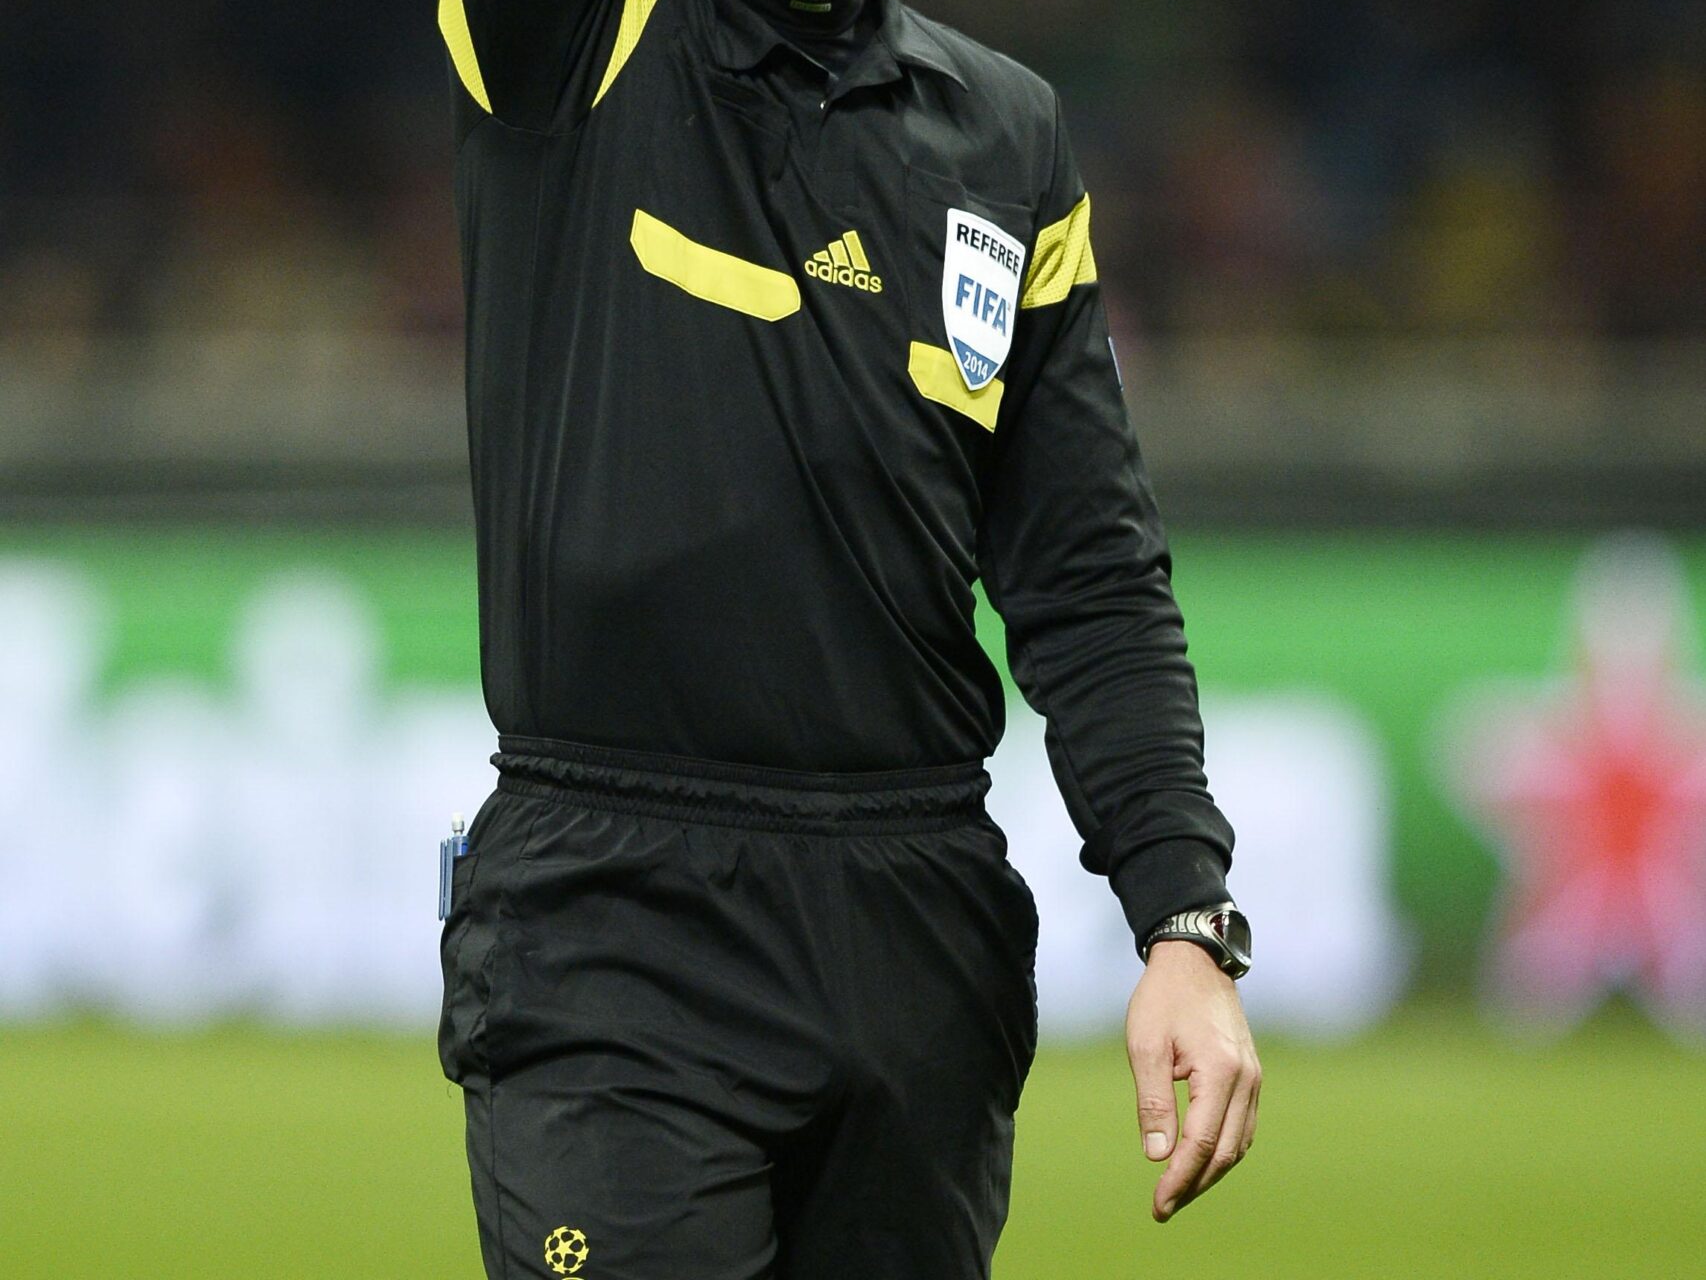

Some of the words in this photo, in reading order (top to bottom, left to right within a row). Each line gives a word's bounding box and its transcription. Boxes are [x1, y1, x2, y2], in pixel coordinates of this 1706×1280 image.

[956, 222, 1020, 276] REFEREE
[804, 259, 883, 294] adidas
[955, 273, 1008, 336] FIFA
[963, 351, 989, 379] 2014
